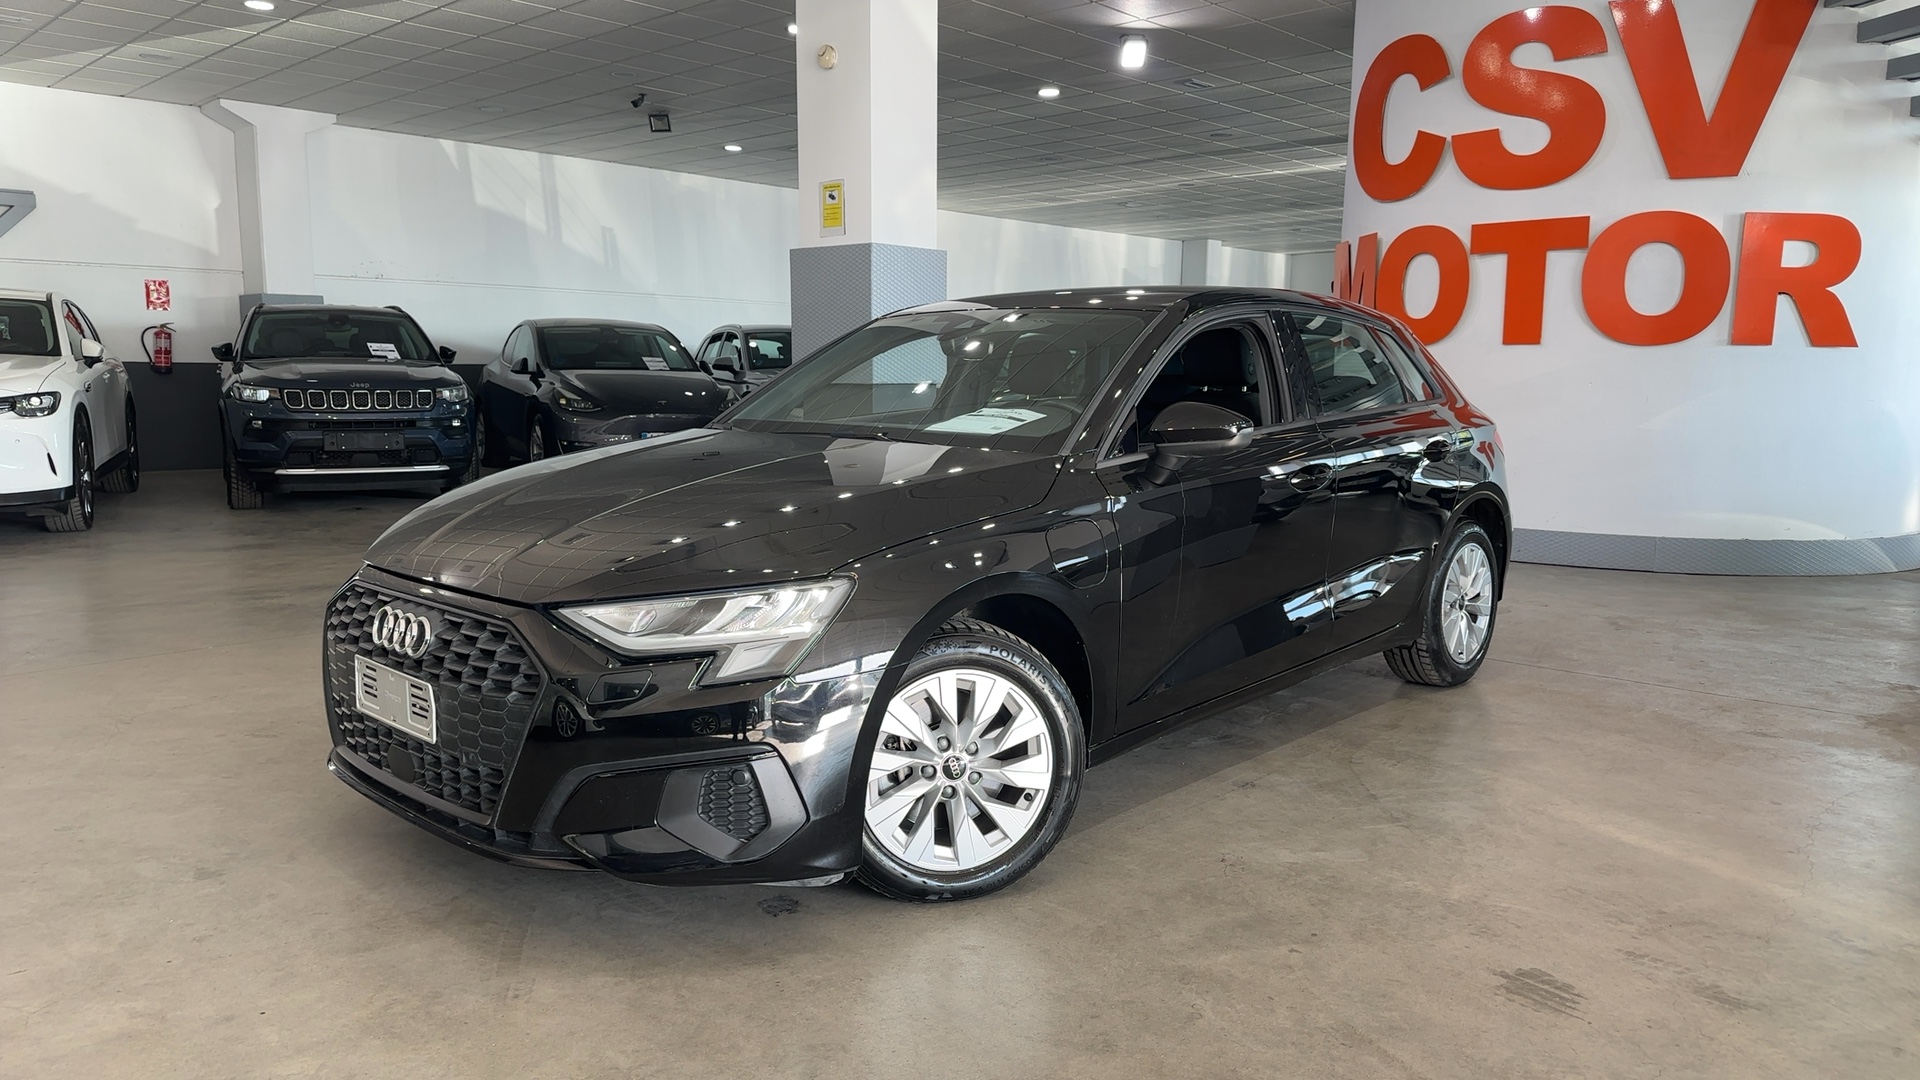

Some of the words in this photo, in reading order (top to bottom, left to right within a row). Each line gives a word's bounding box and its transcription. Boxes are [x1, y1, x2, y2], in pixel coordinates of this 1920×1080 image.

[1353, 0, 1819, 203] CSV
[1334, 211, 1862, 347] MOTOR
[989, 645, 1050, 685] POLARIS
